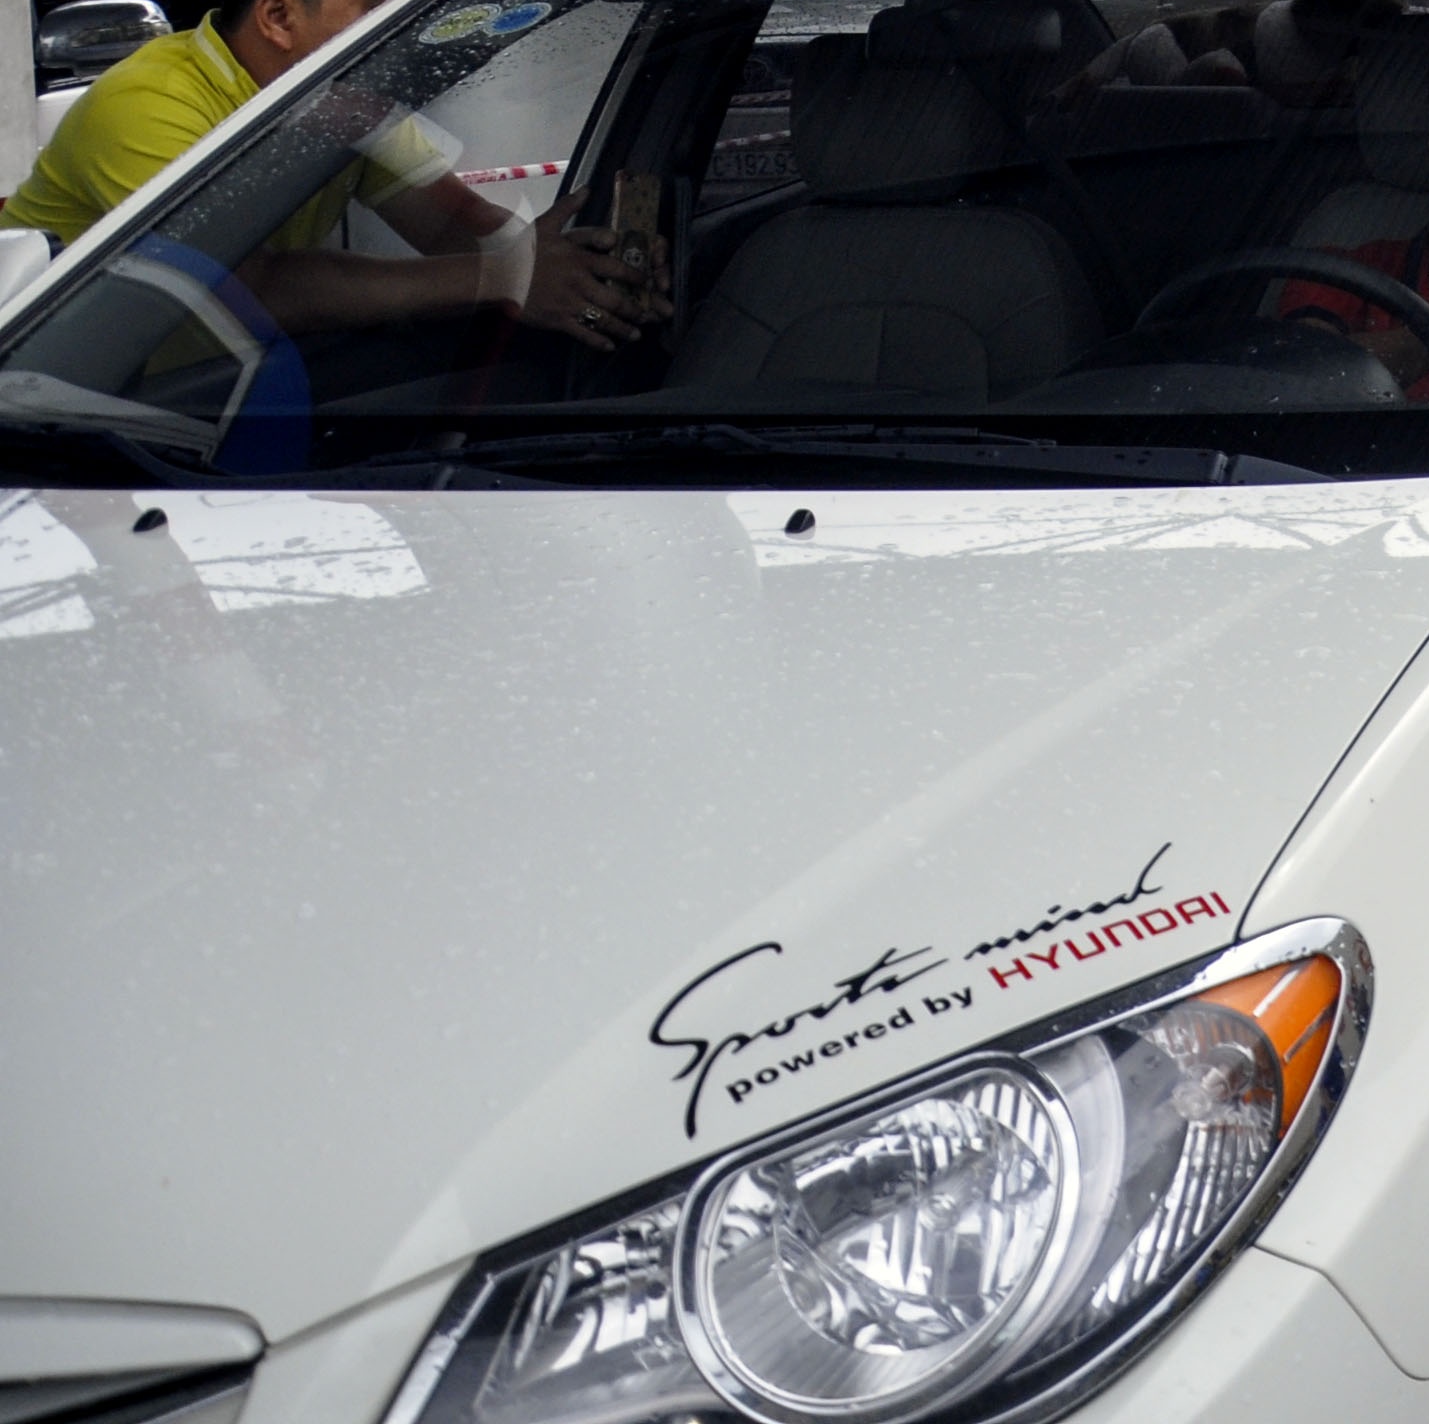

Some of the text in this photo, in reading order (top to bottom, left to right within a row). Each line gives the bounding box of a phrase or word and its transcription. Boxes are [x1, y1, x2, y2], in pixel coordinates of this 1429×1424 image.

[648, 841, 1172, 1139] Sports mind
[725, 889, 1232, 1105] powered by HYUNDAI
